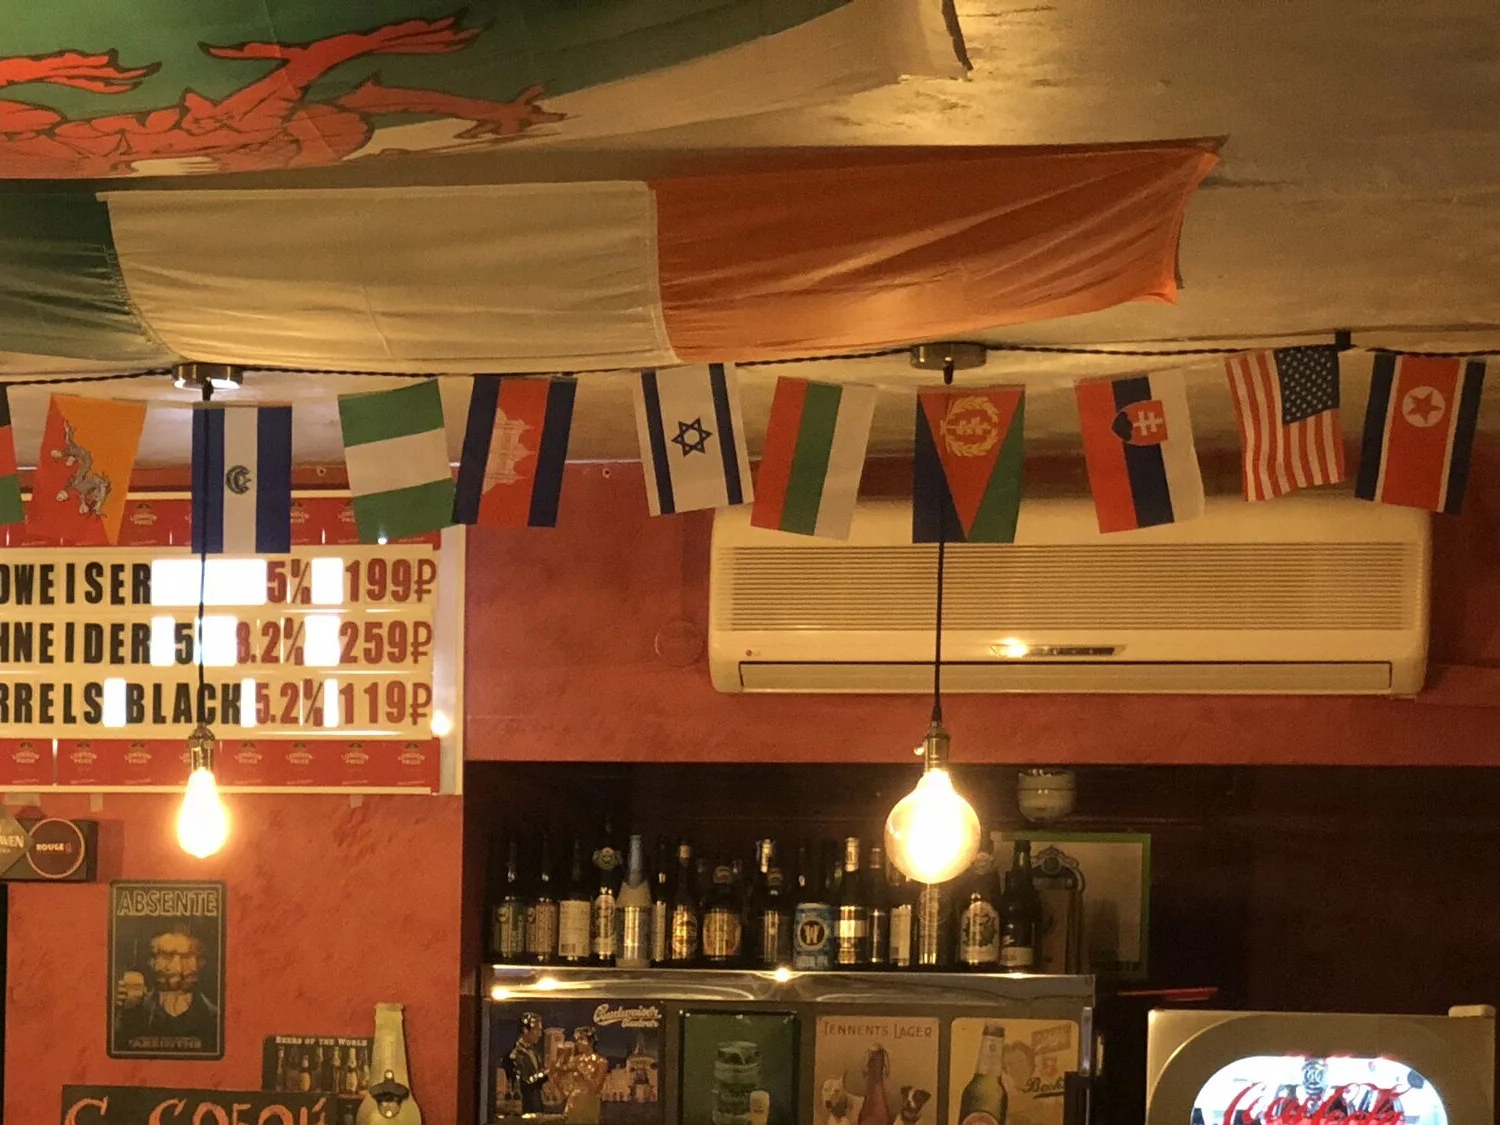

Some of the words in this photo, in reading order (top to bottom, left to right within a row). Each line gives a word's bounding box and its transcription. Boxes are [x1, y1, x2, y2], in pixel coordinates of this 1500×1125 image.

[266, 558, 310, 605] 5%
[345, 558, 437, 604] 199₽
[174, 622, 194, 664] 5
[339, 620, 432, 664] 259₽
[126, 681, 240, 725] BLACK
[256, 679, 323, 726] 5.2%
[339, 680, 432, 725] 119₽
[117, 889, 218, 917] ABSENTE
[338, 1038, 368, 1047] WORLD
[822, 1020, 889, 1037] TENNENTS
[894, 1021, 932, 1039] LAGER
